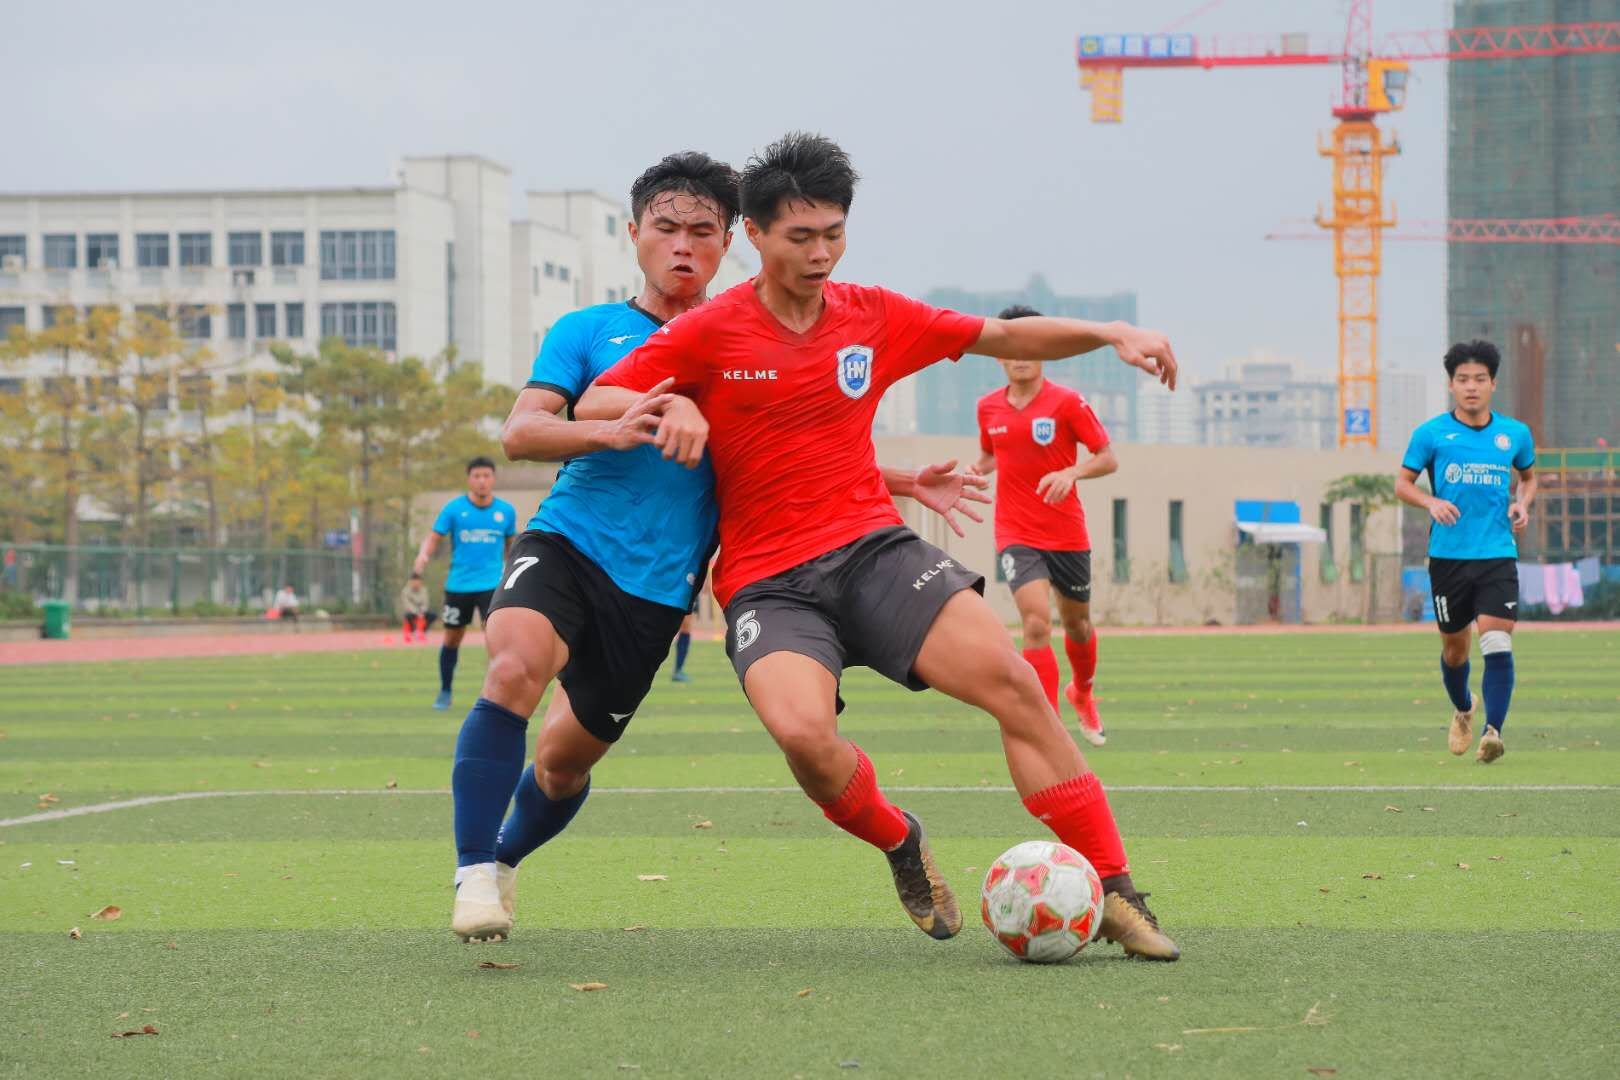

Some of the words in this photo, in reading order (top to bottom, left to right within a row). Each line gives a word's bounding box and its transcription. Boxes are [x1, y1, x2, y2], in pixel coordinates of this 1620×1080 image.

[723, 369, 778, 380] KELME
[846, 360, 866, 379] HN
[1350, 410, 1367, 432] 2
[503, 556, 540, 590] 7
[912, 559, 954, 590] KELME
[735, 609, 761, 652] 5
